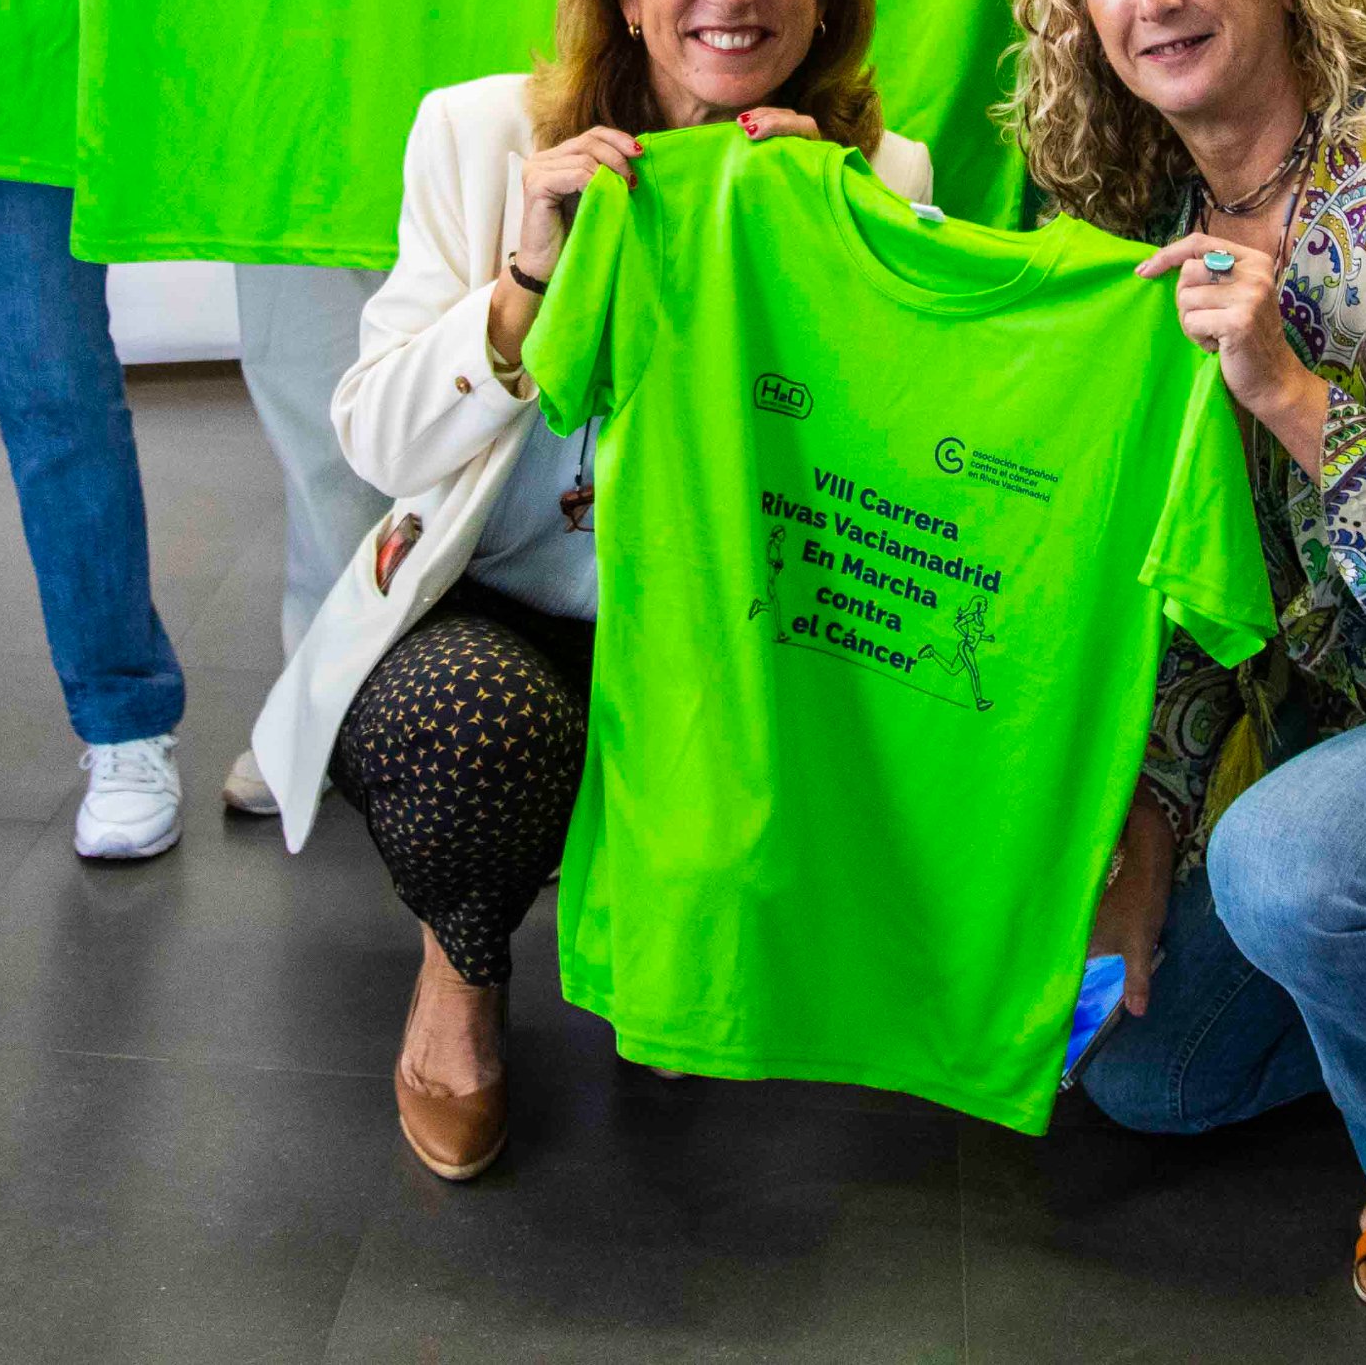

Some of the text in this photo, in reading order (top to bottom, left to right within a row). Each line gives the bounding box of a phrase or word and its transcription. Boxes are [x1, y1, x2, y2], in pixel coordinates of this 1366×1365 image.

[762, 380, 805, 407] H2O
[814, 467, 959, 542] VIII Carrera
[761, 491, 1002, 594] Rivas Vaciamadrid
[802, 539, 938, 609] En Marcha
[816, 586, 902, 633] contra
[792, 614, 918, 674] el Cáncer
